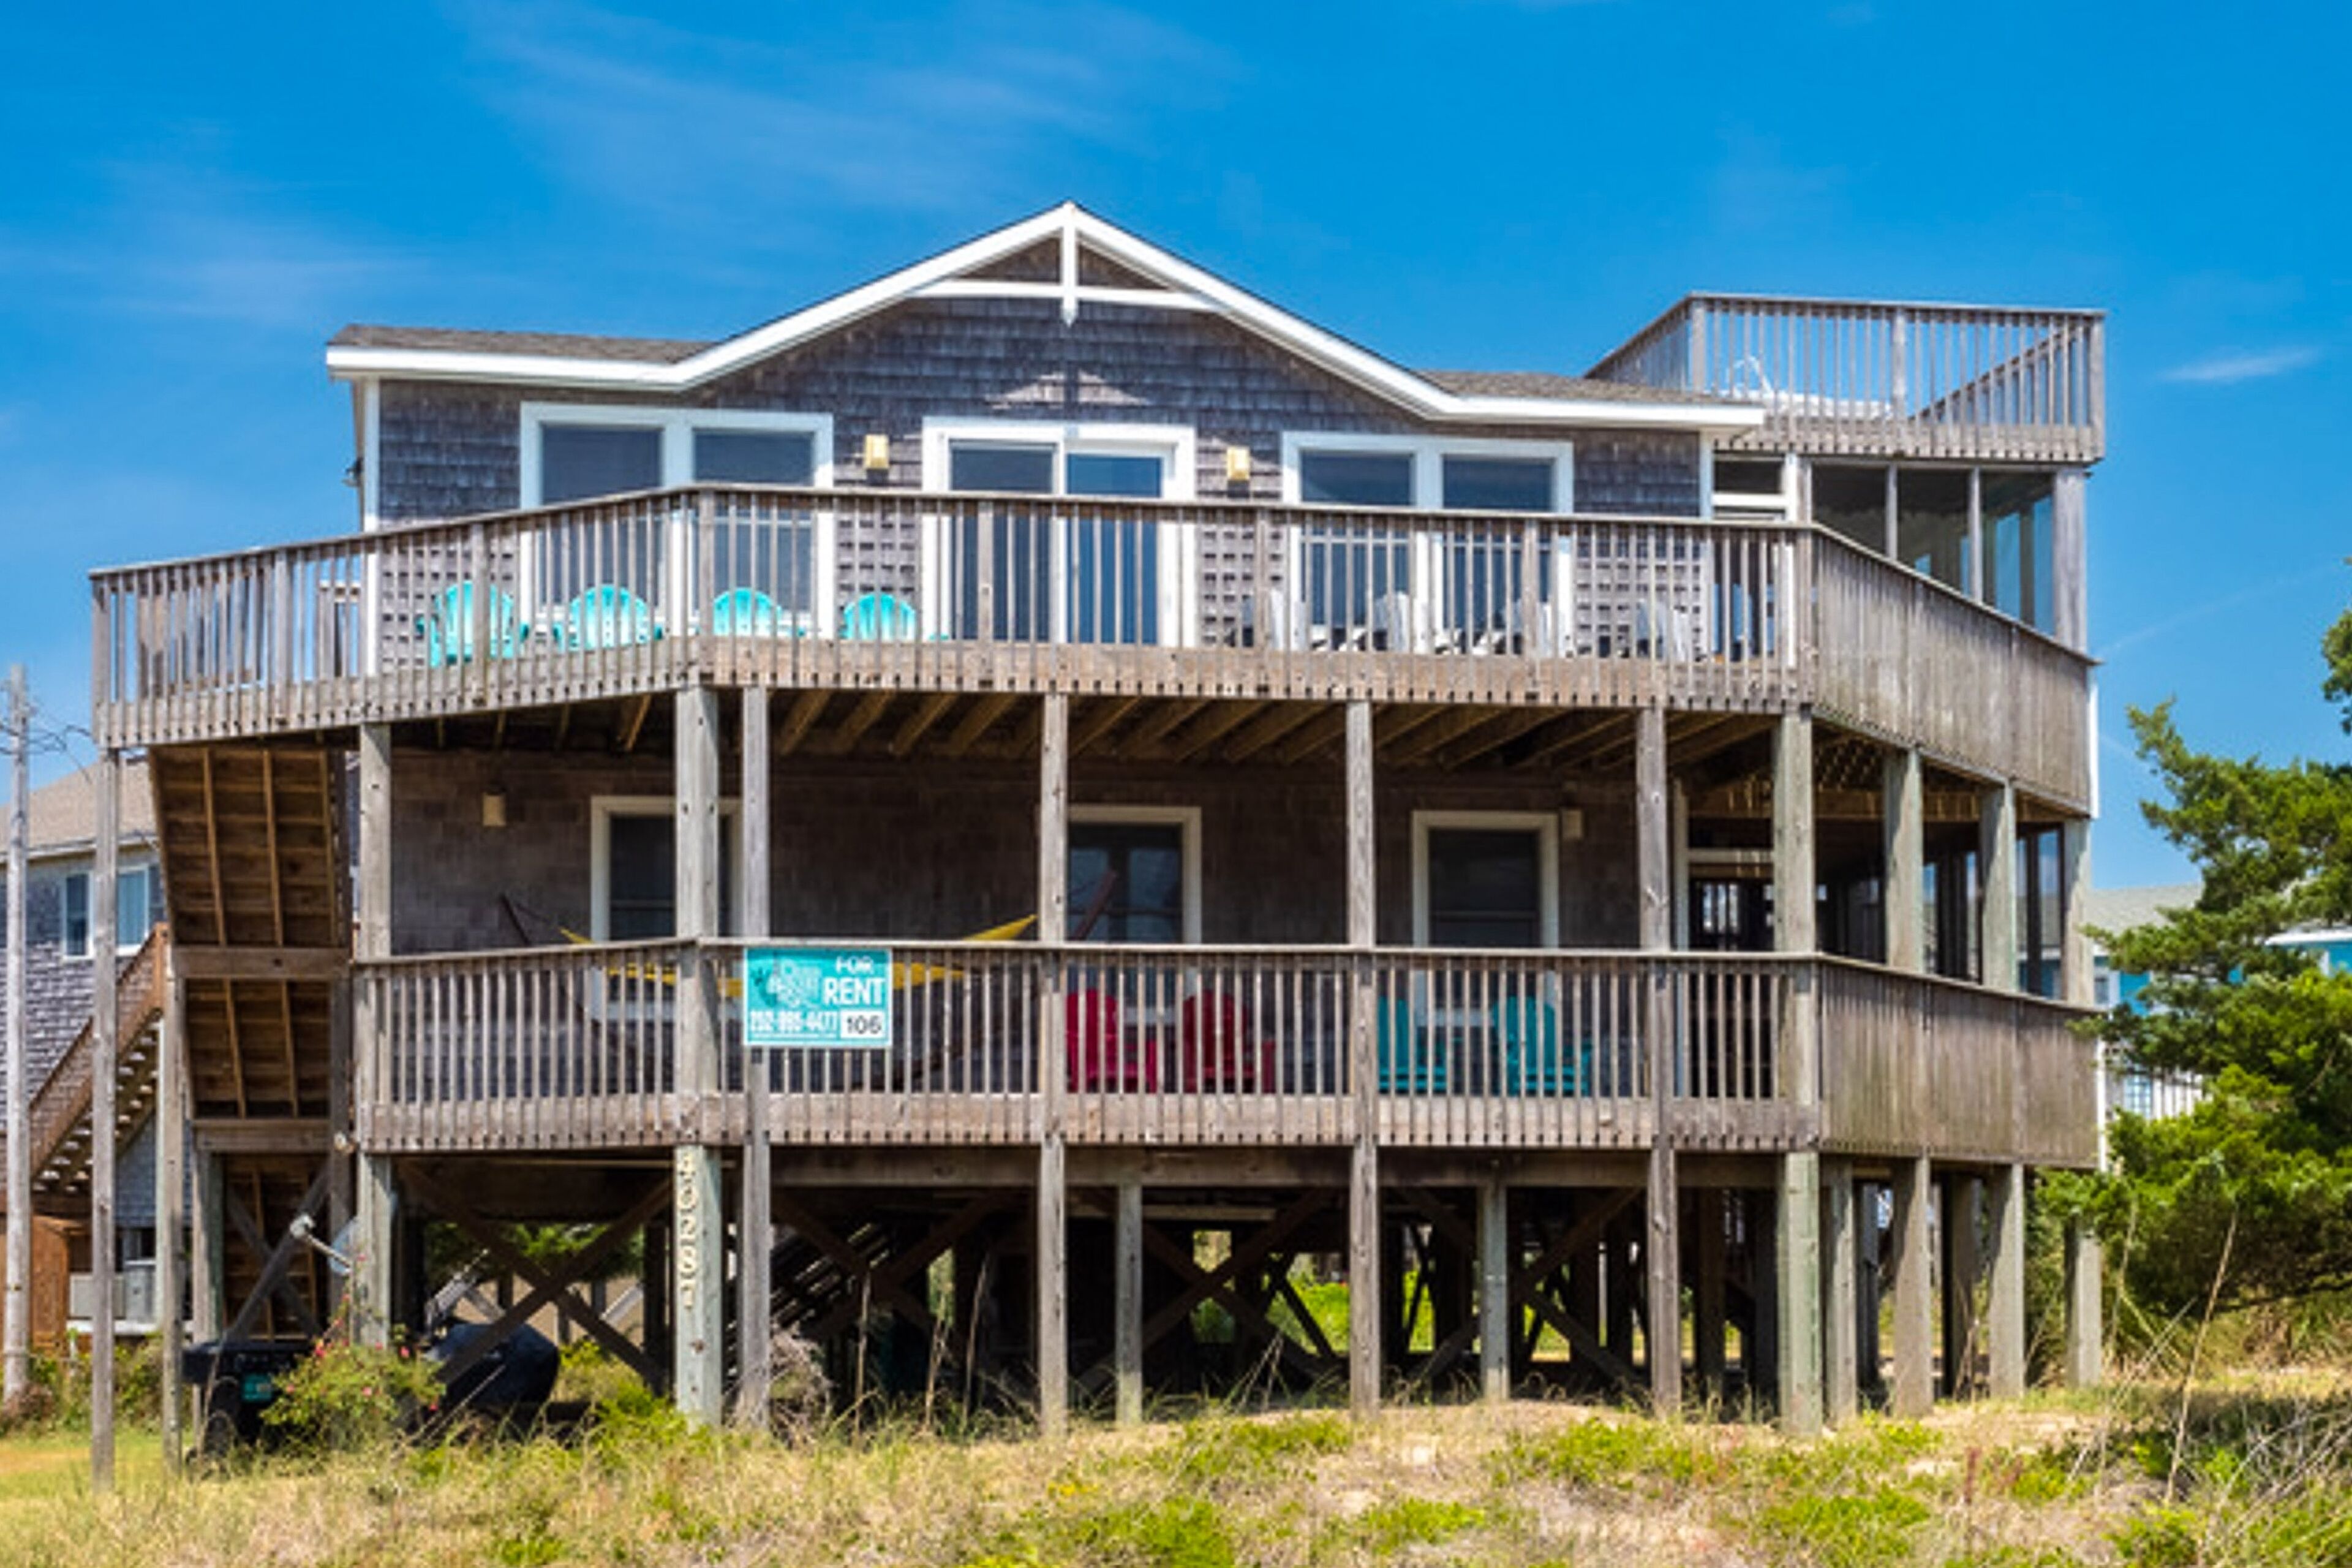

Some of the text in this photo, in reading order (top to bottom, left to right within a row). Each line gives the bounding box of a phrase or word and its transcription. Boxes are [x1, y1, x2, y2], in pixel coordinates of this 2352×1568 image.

[835, 956, 875, 974] FOR
[824, 978, 886, 1005] RENT
[846, 1015, 882, 1035] 106
